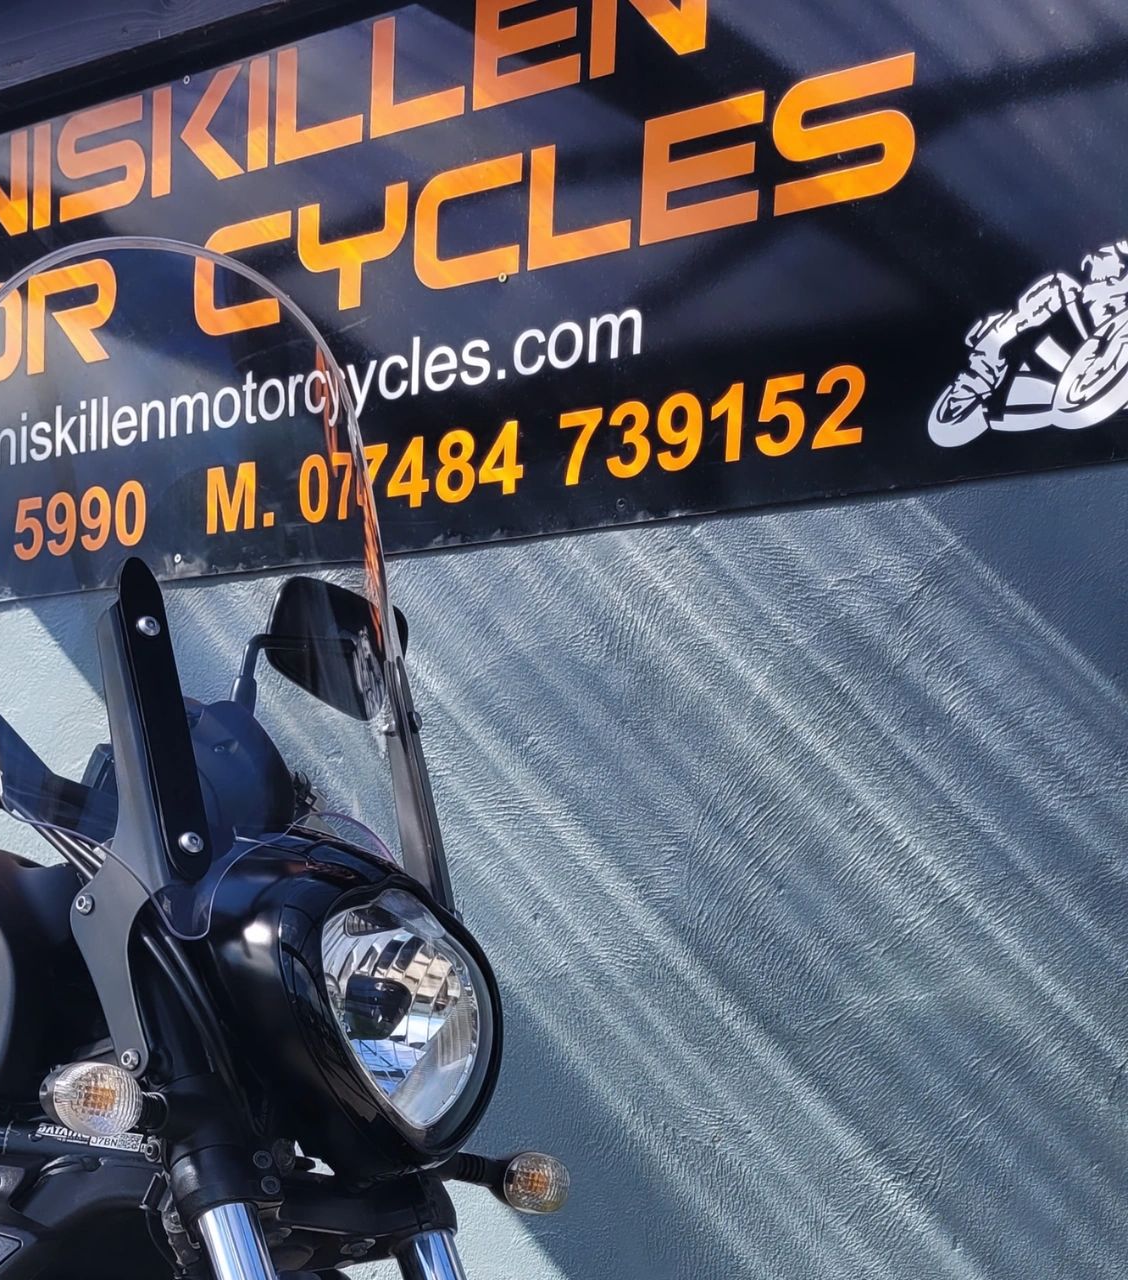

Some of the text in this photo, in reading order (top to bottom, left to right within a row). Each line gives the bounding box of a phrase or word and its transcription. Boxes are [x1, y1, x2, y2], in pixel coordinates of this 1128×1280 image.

[193, 52, 916, 336] CYCLES
[13, 480, 147, 562] 5990
[205, 461, 275, 536] M.
[559, 364, 867, 487] 739152
